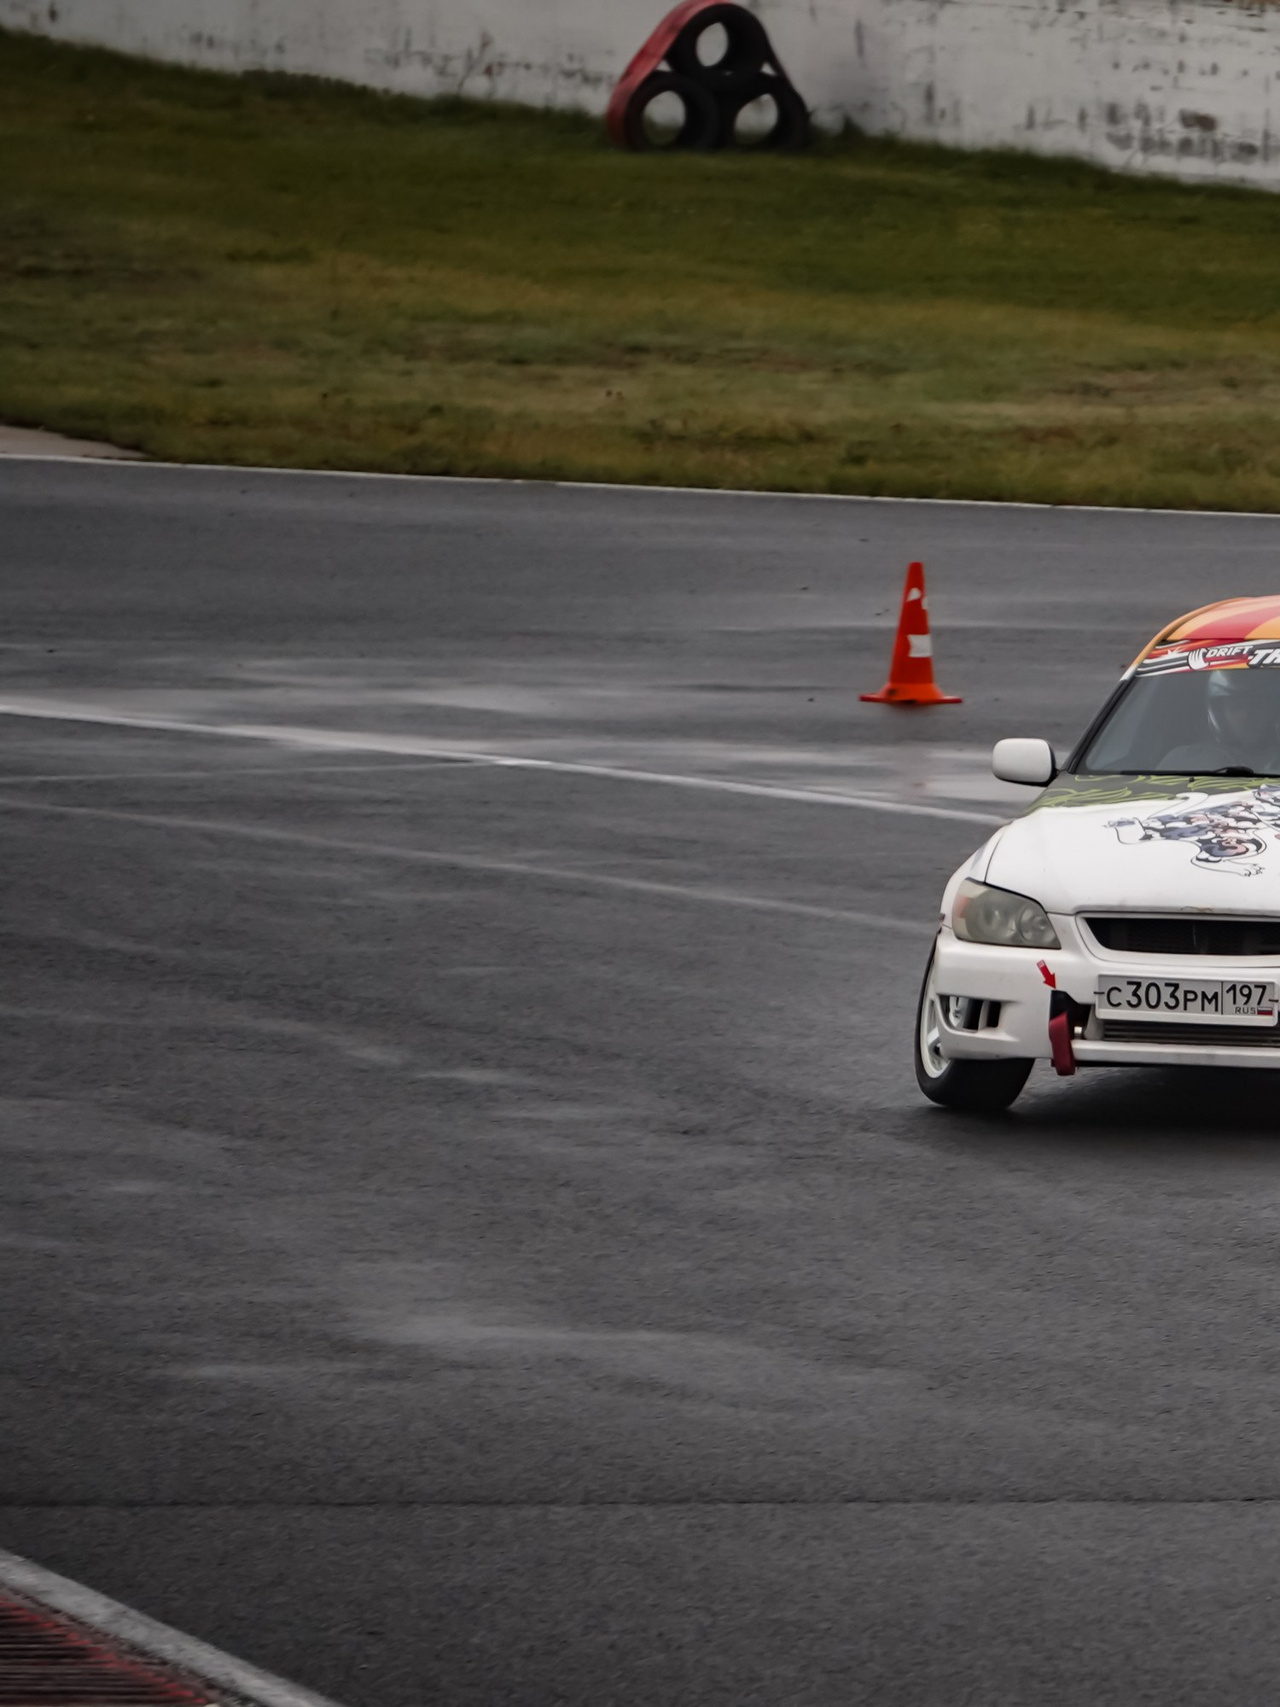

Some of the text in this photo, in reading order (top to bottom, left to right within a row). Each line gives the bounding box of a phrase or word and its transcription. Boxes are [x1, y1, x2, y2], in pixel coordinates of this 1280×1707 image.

[1206, 645, 1252, 659] DRIFT
[1106, 980, 1267, 1012] С303РМ 197
[1234, 1006, 1256, 1015] RUS
